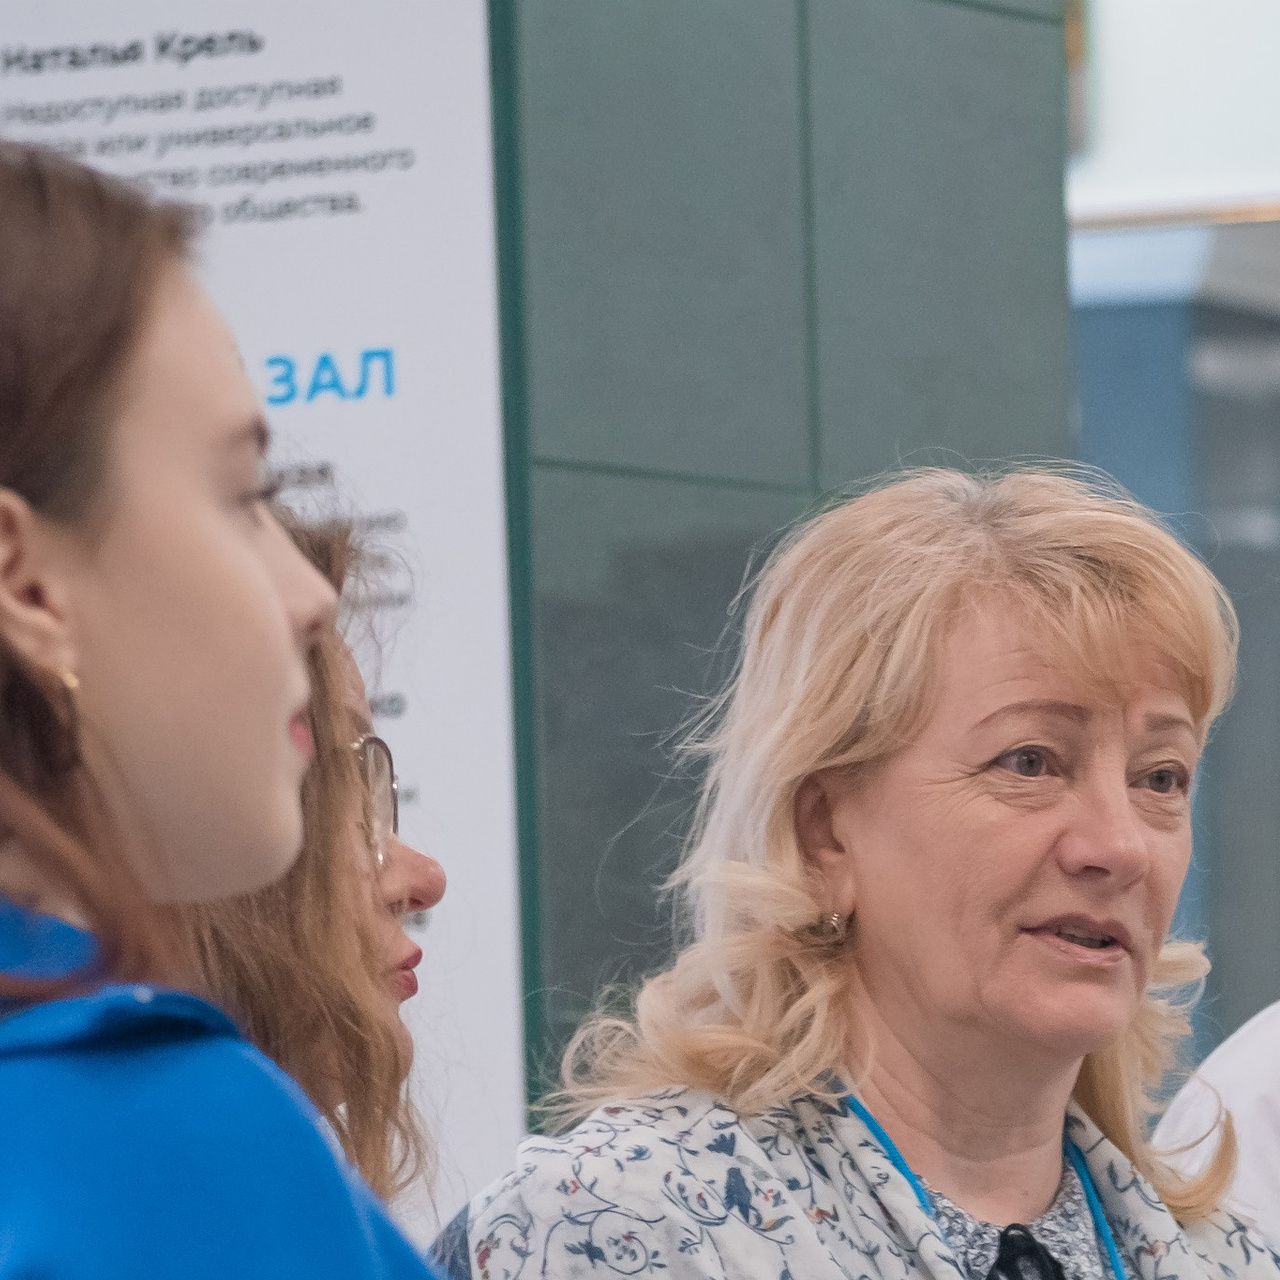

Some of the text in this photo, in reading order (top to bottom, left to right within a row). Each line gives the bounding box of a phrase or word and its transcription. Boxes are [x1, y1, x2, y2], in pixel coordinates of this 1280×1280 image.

[1, 40, 144, 75] Наталья
[195, 77, 342, 112] доступная
[155, 113, 374, 158] универсальное
[206, 149, 415, 187] современного
[265, 348, 394, 405] ЗАЛ
